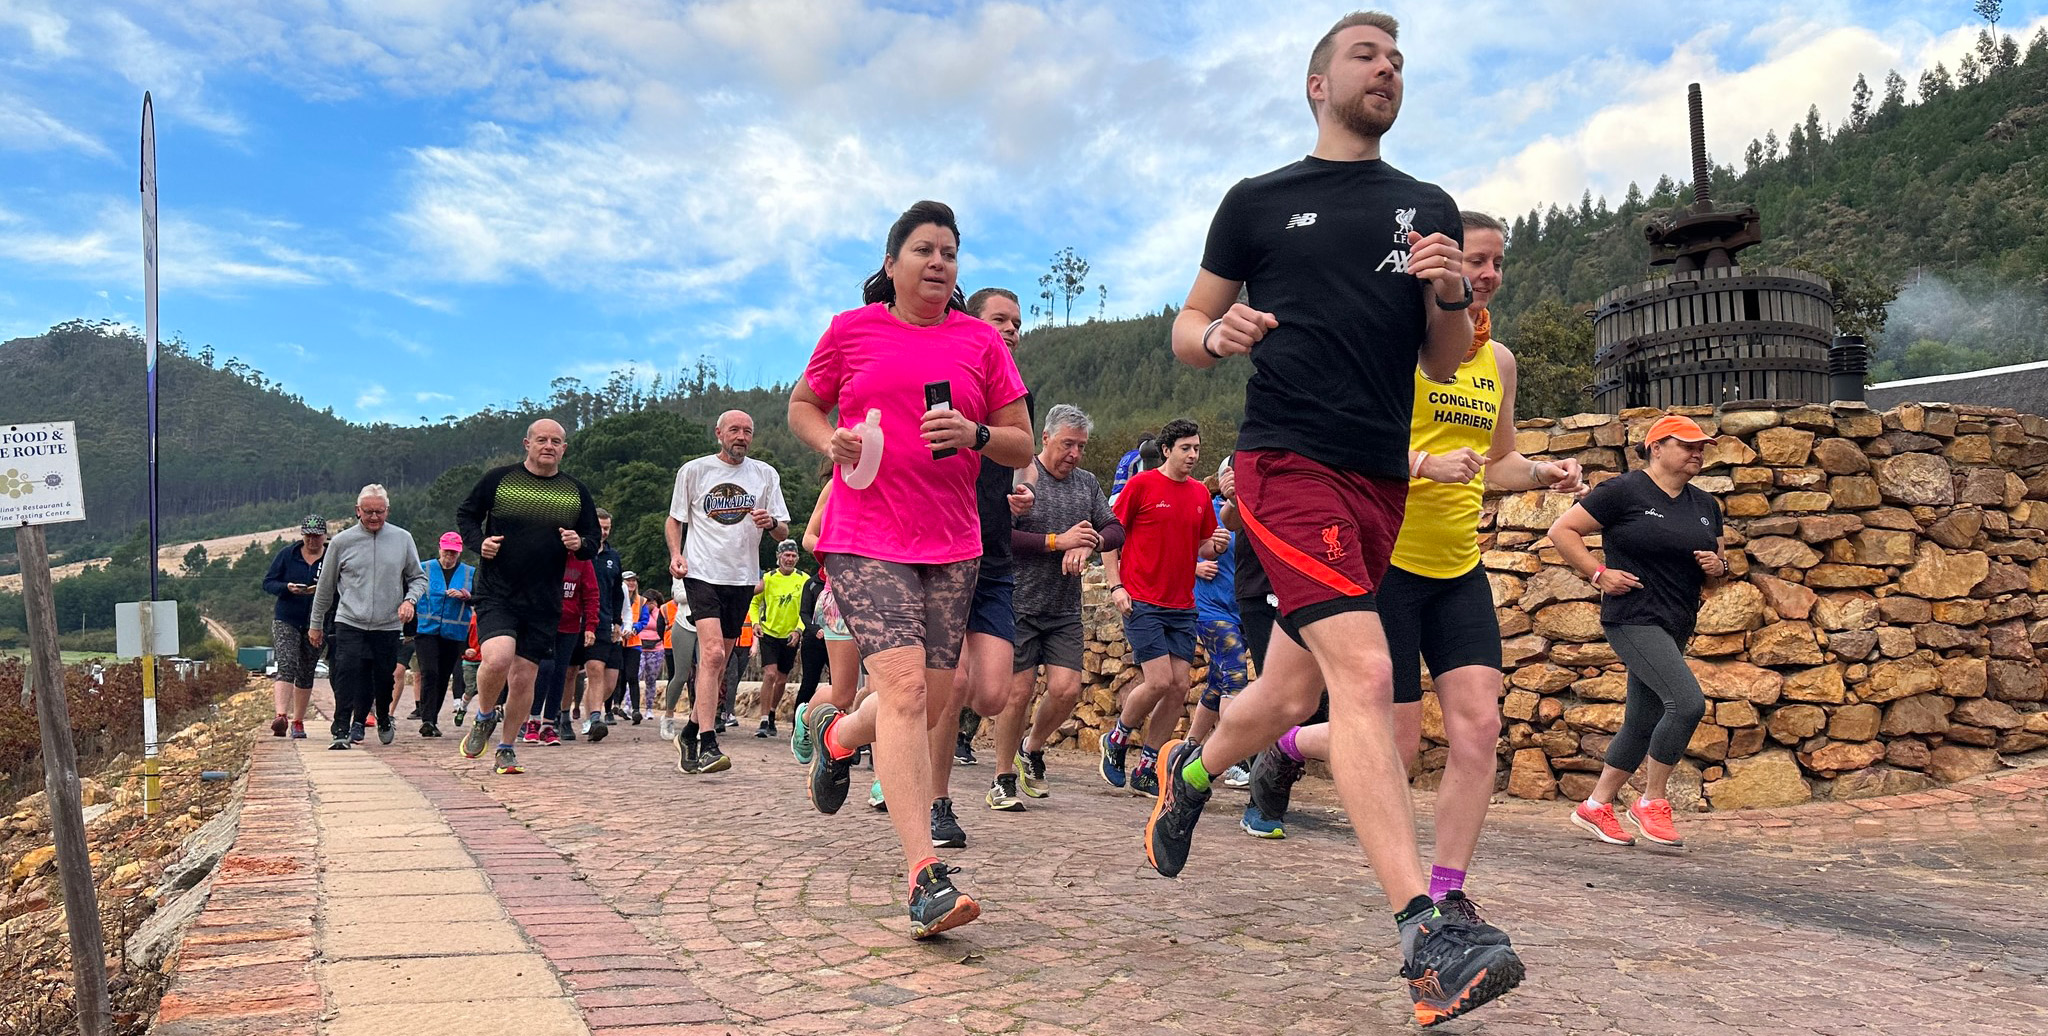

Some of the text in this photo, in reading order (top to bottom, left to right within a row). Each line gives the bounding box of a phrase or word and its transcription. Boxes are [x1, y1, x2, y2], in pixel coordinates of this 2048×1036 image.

[1374, 249, 1413, 274] AX
[1472, 376, 1495, 392] LFR
[1428, 391, 1496, 415] CONGLETON
[1434, 410, 1493, 431] HARRIERS
[3, 431, 63, 444] FOOD &
[13, 444, 67, 457] ROUTE
[22, 502, 63, 511] Restaurant
[16, 512, 43, 520] Tasting
